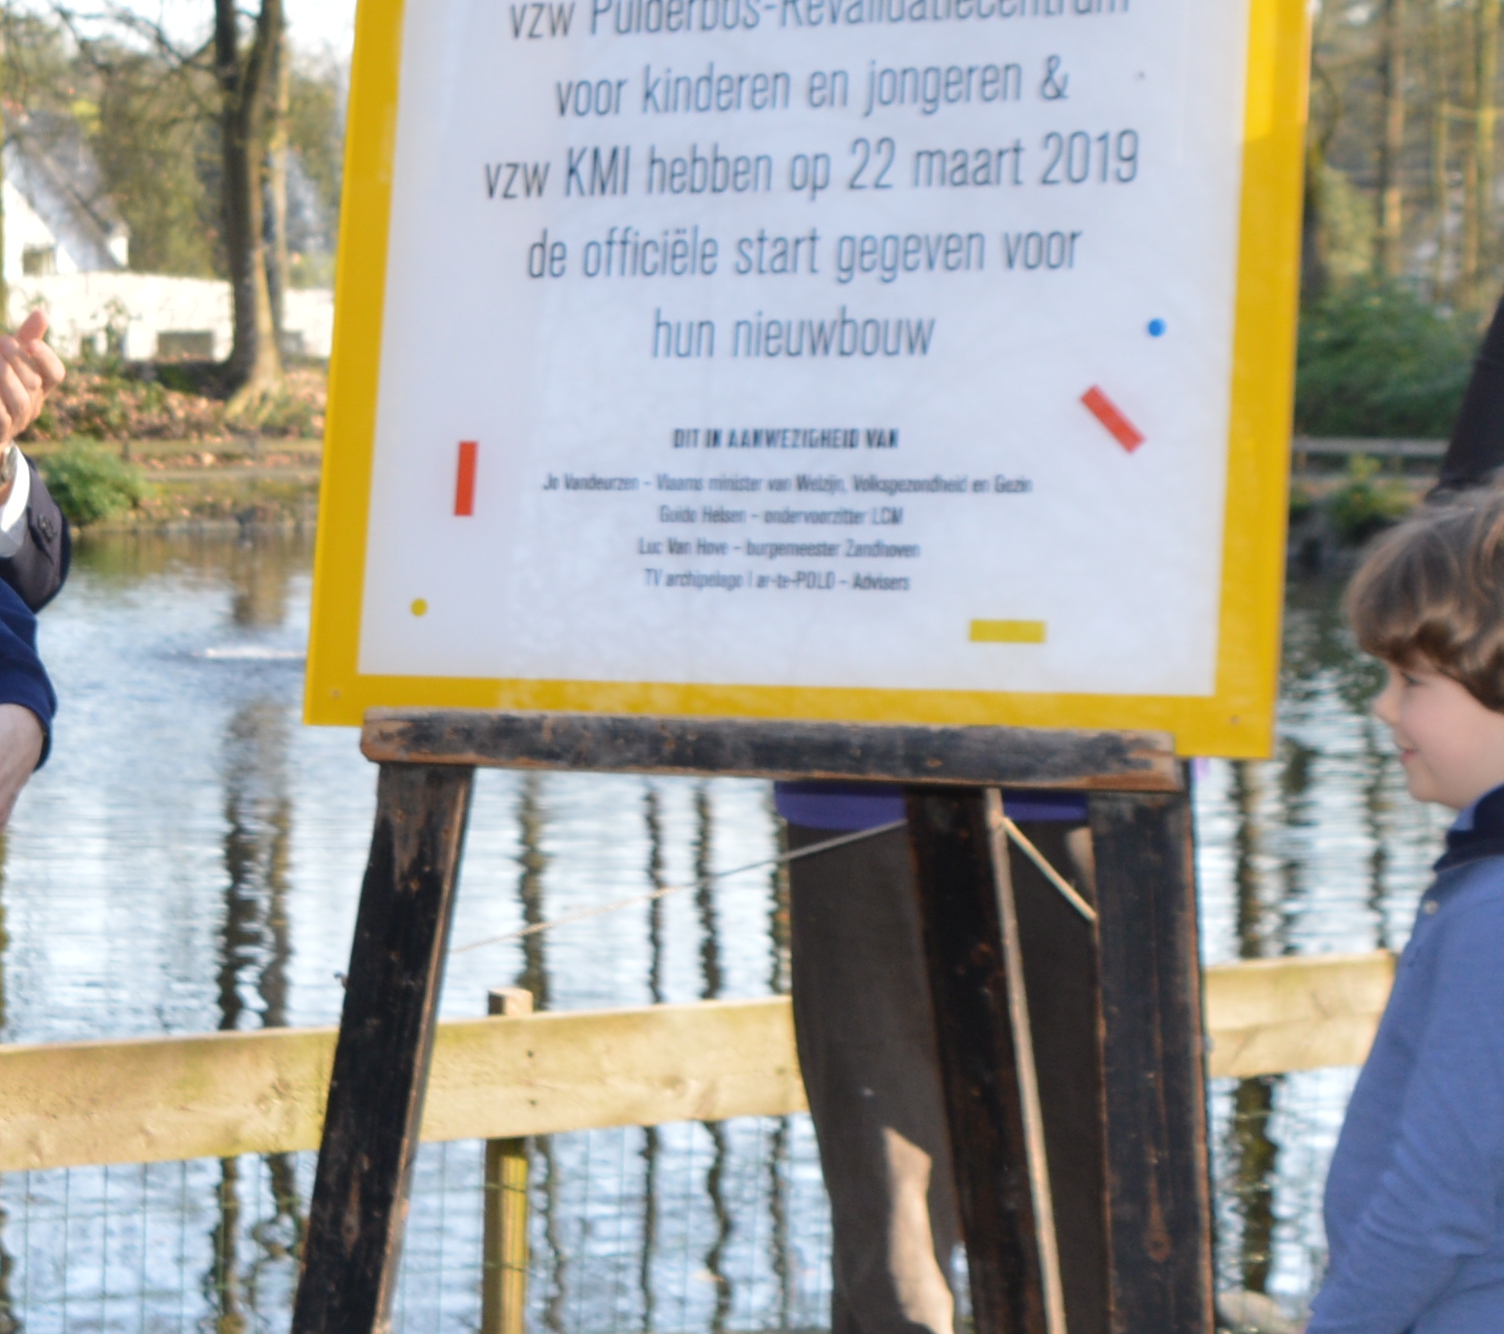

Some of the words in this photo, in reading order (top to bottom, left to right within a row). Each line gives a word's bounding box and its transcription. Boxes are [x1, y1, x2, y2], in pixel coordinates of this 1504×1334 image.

[508, 1, 576, 40] vzw
[555, 79, 628, 118] voor
[642, 62, 791, 114] kinderen
[805, 70, 848, 109] en
[863, 60, 1022, 116] jongeren
[1038, 54, 1069, 102] &
[483, 161, 551, 200] vzw
[563, 145, 631, 197] KMI
[645, 144, 773, 195] hebben
[786, 153, 831, 202] op
[845, 136, 896, 191] 22
[911, 139, 1026, 188] maart
[1037, 128, 1140, 186] 2019
[526, 228, 567, 280] de
[582, 225, 718, 278] officiële
[734, 228, 820, 275] start
[835, 232, 985, 285] gegeven
[1002, 230, 1082, 271] voor
[652, 308, 715, 358] hun
[732, 306, 935, 358] nieuwbouw
[672, 427, 700, 449] DIT
[704, 427, 722, 449] IN
[727, 427, 860, 450] AANWEZIGHEID
[864, 427, 899, 450] VAN
[638, 538, 662, 555] Luc
[667, 538, 691, 555] Van
[696, 538, 728, 555] Hove
[746, 539, 842, 559] burgemeester
[845, 539, 921, 558] Zandhoven
